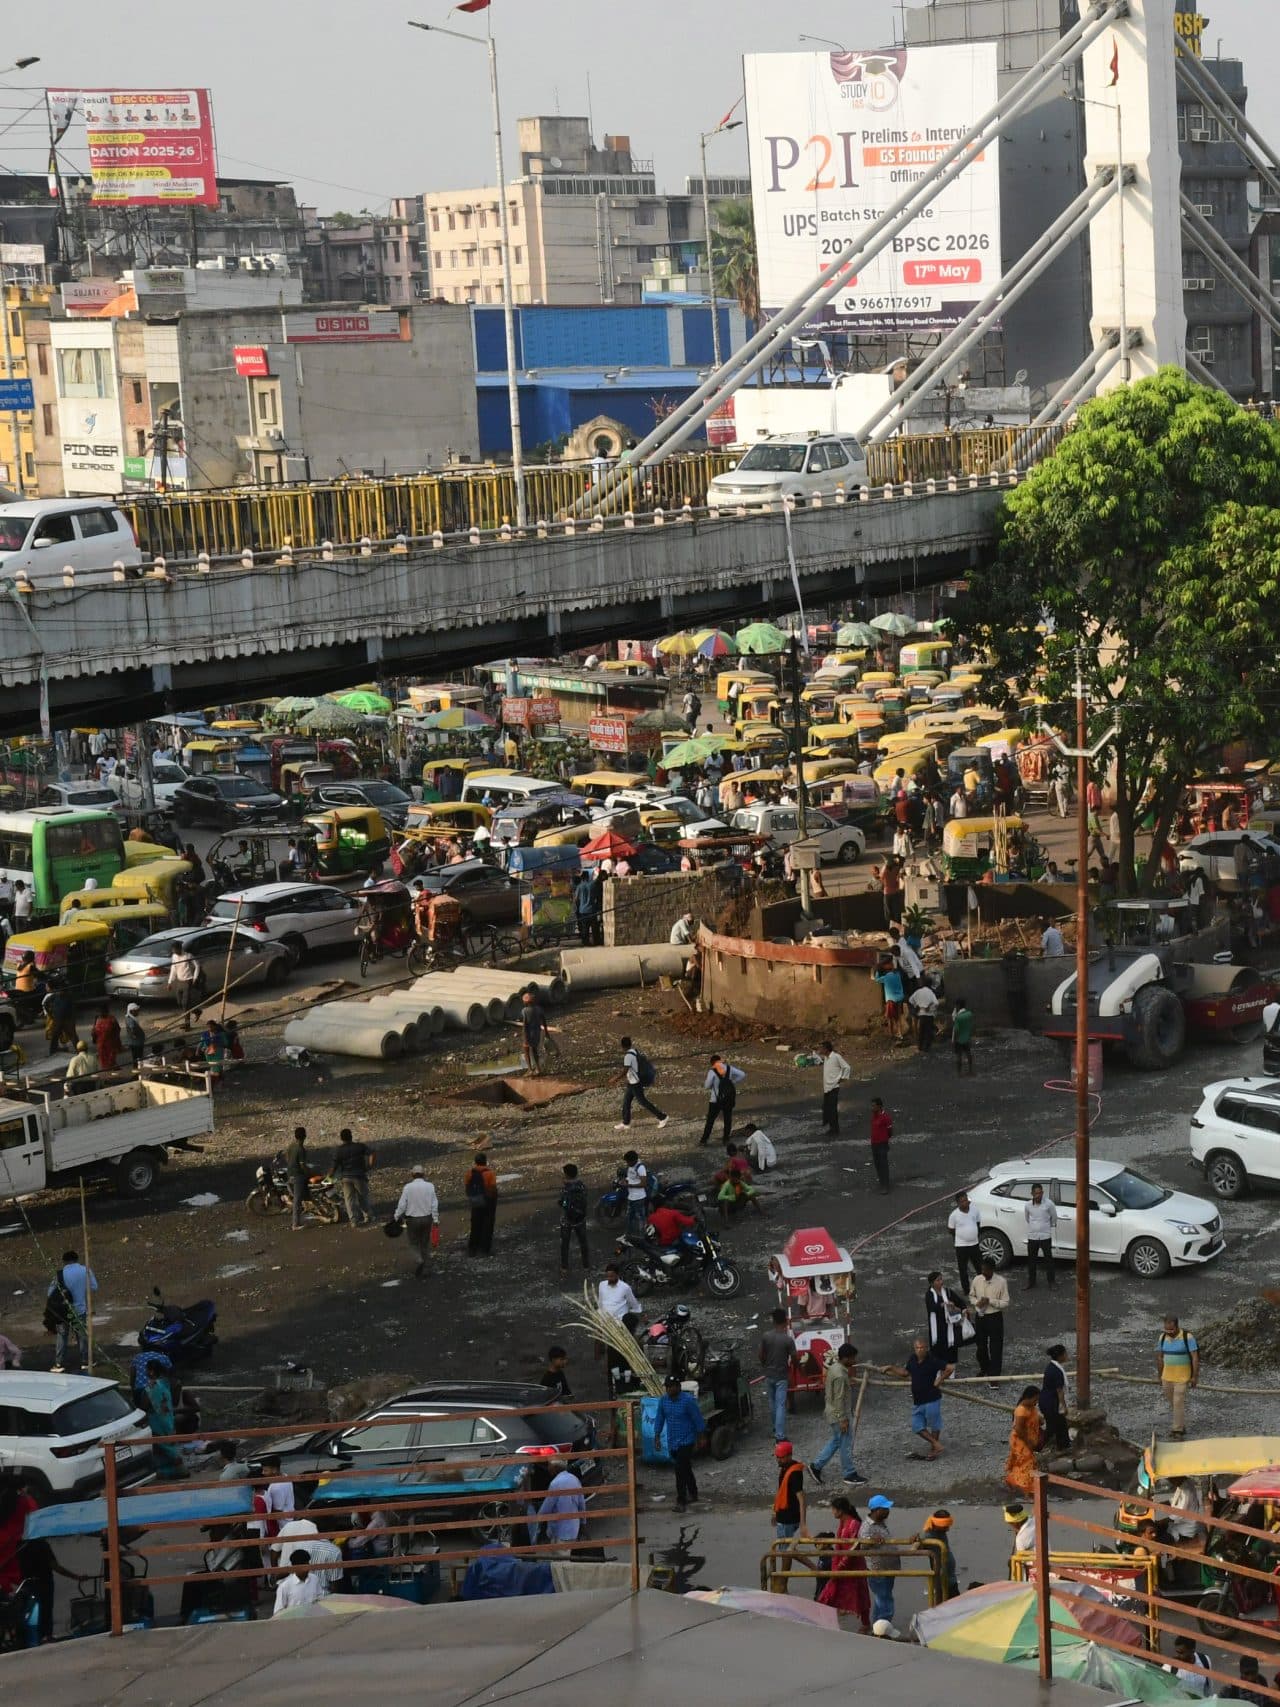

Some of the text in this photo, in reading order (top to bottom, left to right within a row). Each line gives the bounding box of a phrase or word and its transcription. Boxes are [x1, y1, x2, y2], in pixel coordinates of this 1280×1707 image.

[840, 82, 868, 99] STUDY
[862, 130, 908, 144] Prelims
[911, 130, 923, 142] to
[143, 146, 195, 157] 2025-26
[879, 148, 896, 163] GS
[764, 131, 860, 193] P2I
[821, 209, 860, 222] Batch
[892, 233, 990, 253] BPSC 2026
[914, 264, 970, 280] 17th May
[73, 288, 101, 297] SUJATA
[859, 296, 932, 310] 9667176917
[318, 318, 368, 331] USHA
[63, 443, 119, 457] PIONEER
[71, 462, 116, 472] ELECTRONICS
